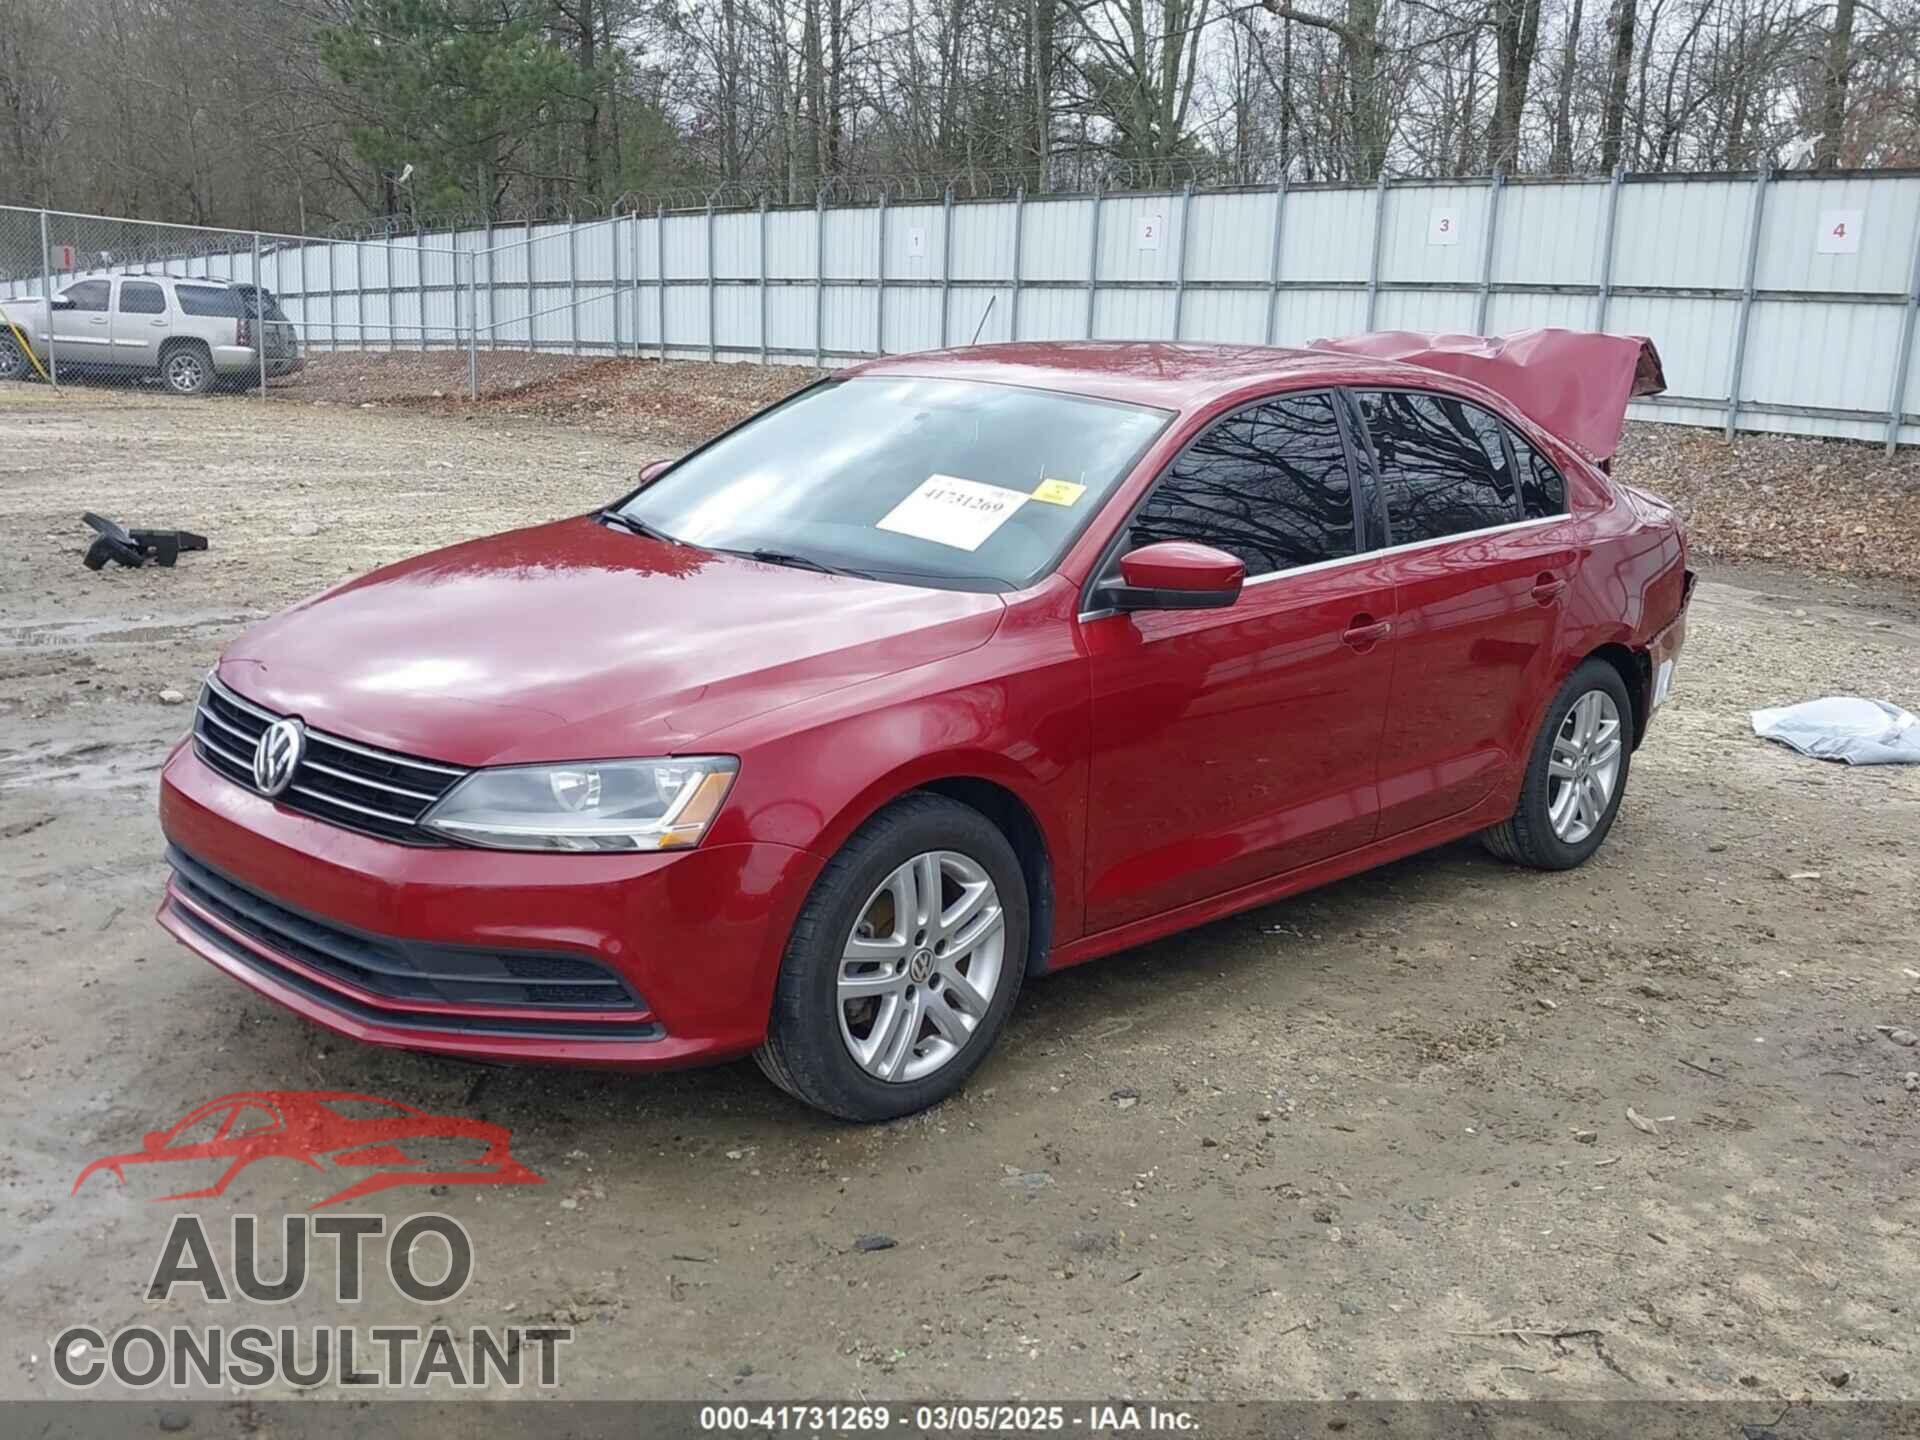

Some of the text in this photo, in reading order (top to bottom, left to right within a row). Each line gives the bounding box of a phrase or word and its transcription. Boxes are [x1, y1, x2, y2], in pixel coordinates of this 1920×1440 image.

[1145, 226, 1152, 238] 2
[1439, 218, 1449, 232] 3
[1832, 223, 1846, 238] 4
[924, 488, 1004, 513] 41731269
